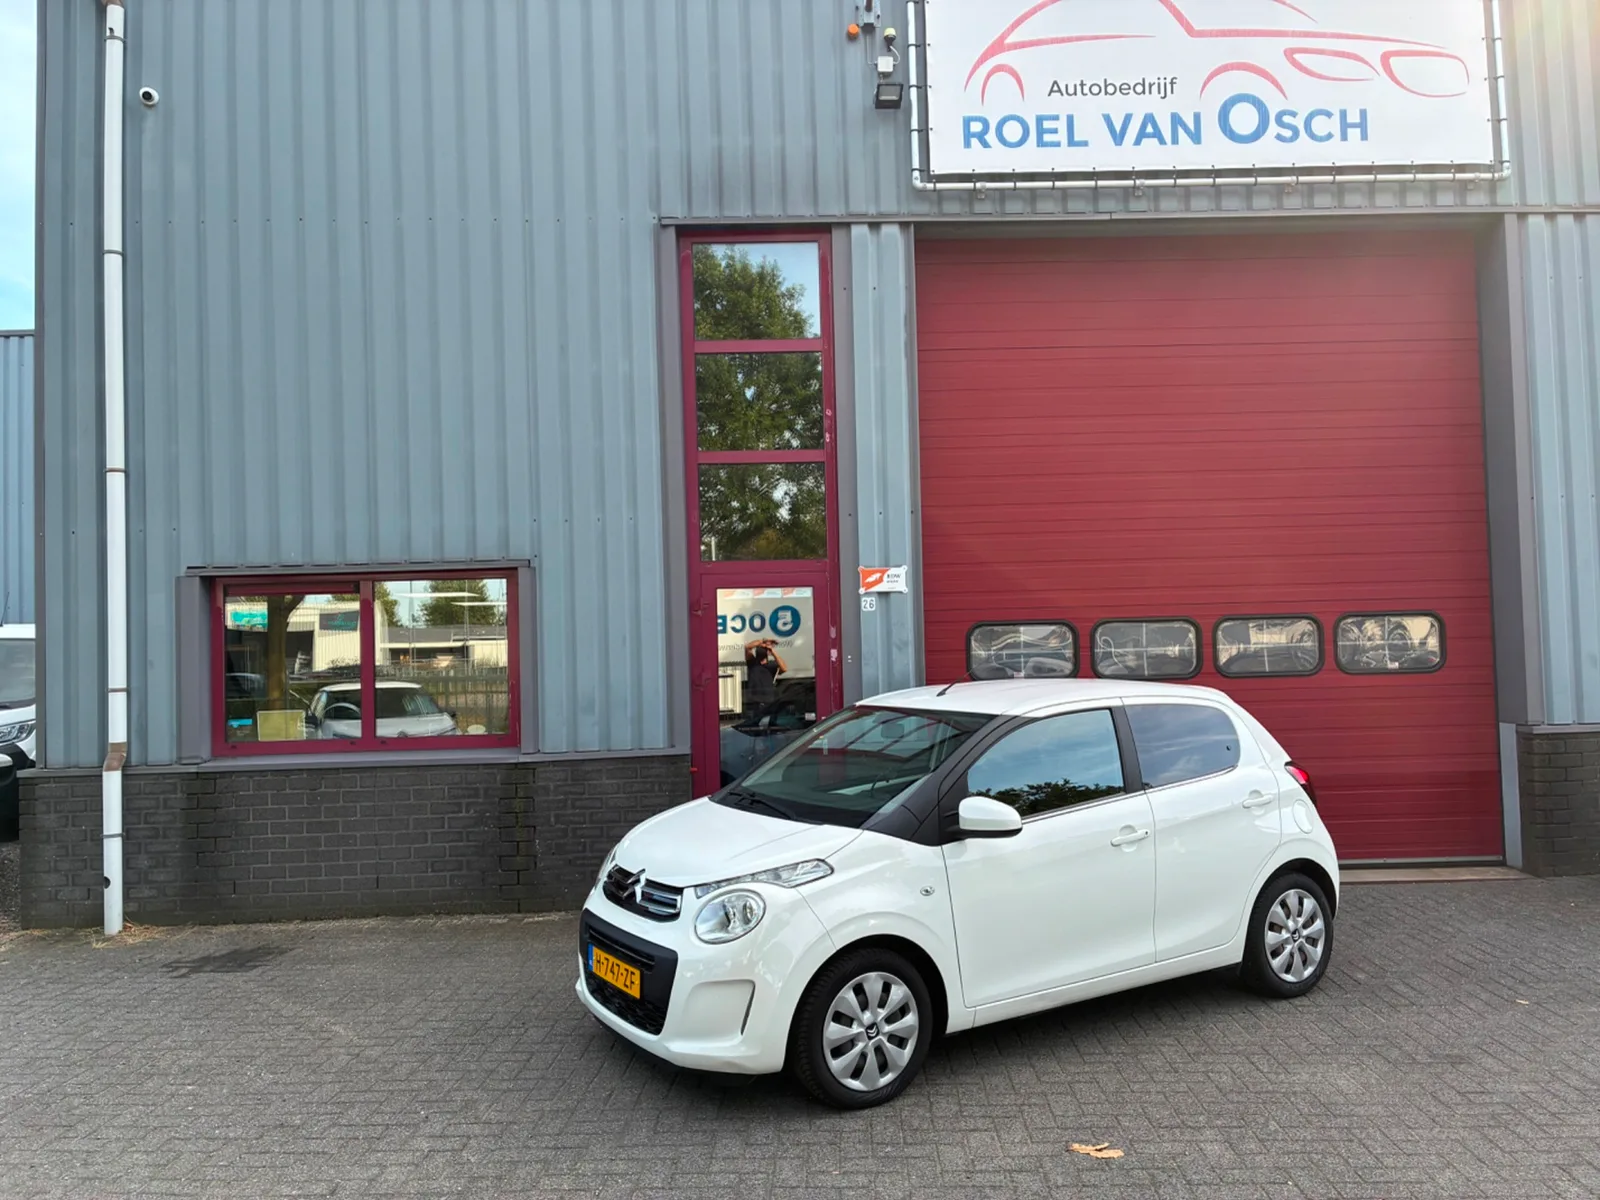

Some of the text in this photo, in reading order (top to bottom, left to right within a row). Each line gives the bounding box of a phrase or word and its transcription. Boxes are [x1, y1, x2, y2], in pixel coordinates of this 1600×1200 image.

[1048, 77, 1178, 99] Autobedrijf
[962, 114, 1089, 149] ROEL
[1102, 111, 1202, 147] VAN
[863, 599, 875, 610] 26
[595, 952, 636, 991] H-747-ZF
